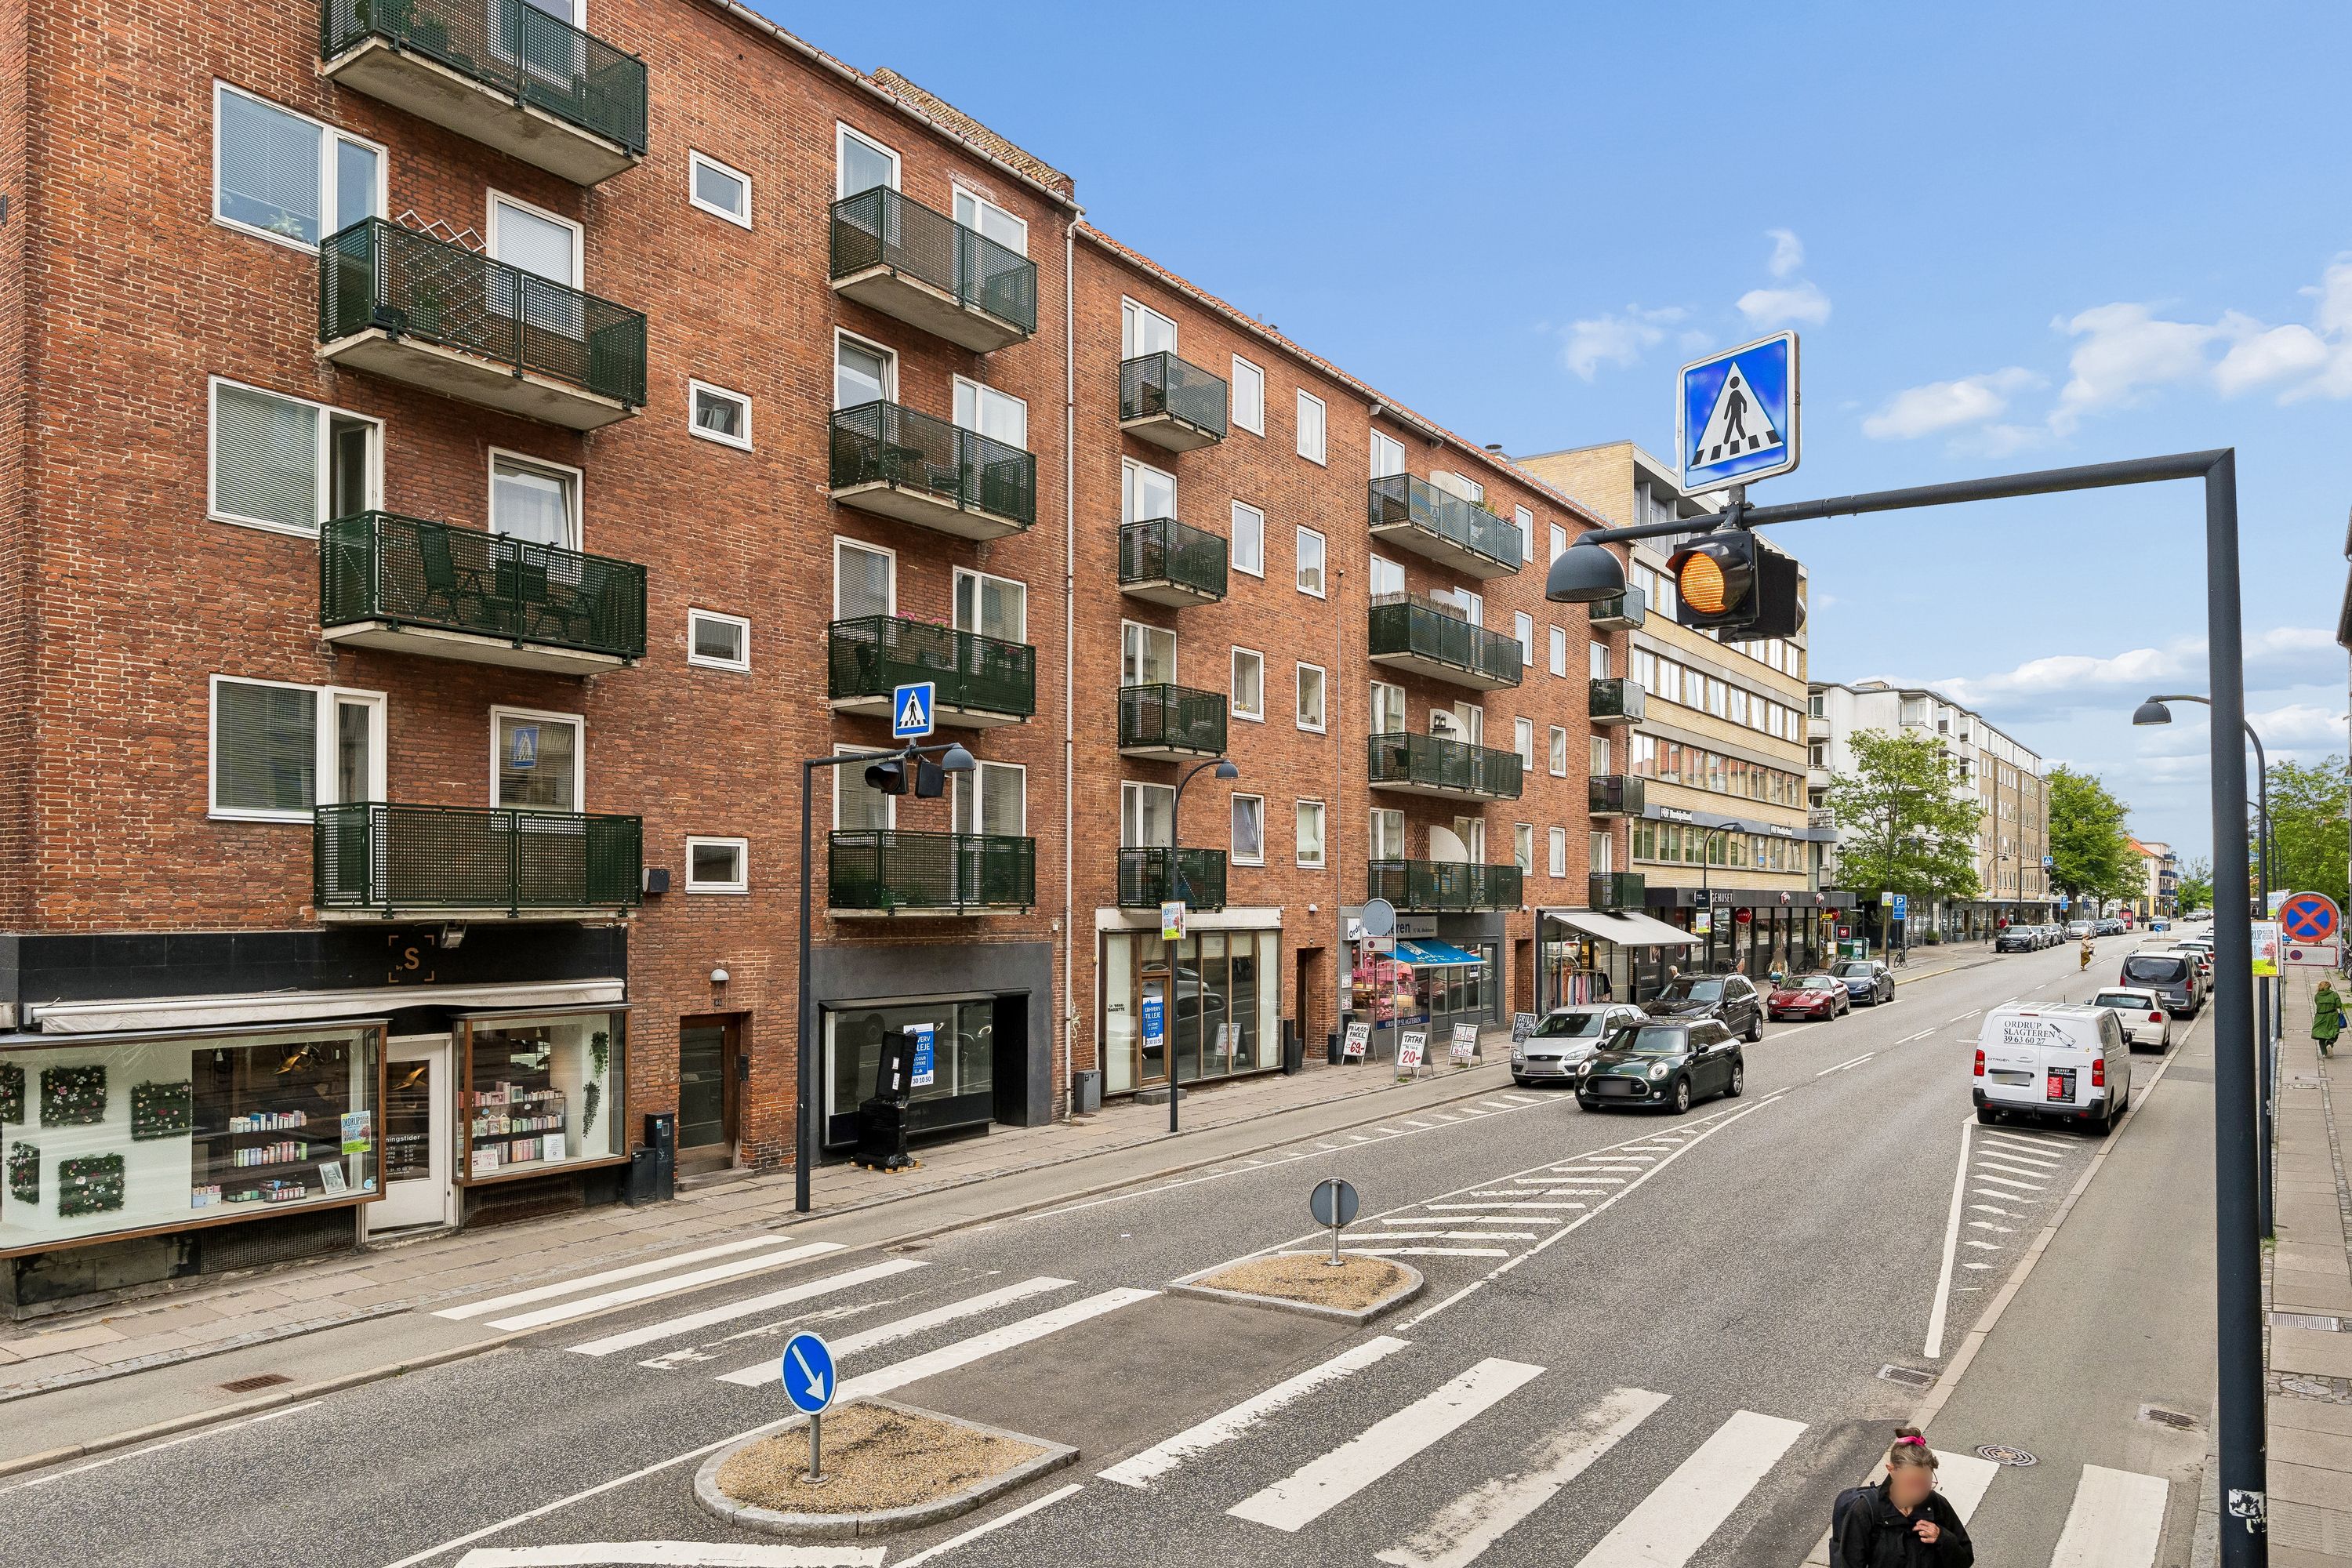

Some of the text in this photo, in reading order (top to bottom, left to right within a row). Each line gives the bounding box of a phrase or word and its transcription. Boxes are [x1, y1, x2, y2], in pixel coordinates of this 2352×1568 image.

[1896, 897, 1904, 906] P
[405, 947, 419, 970] S
[1401, 1017, 1421, 1025] SLAGTEREN
[1518, 1014, 1534, 1023] GRILL
[2004, 1021, 2042, 1029] ORDRUP
[2003, 1028, 2056, 1038] SLAGTEREN
[917, 1035, 931, 1044] VERV
[1404, 1035, 1423, 1044] TATAR
[916, 1043, 931, 1051] LEJE
[919, 1075, 925, 1083] 10
[342, 1116, 360, 1127] ORDRUP
